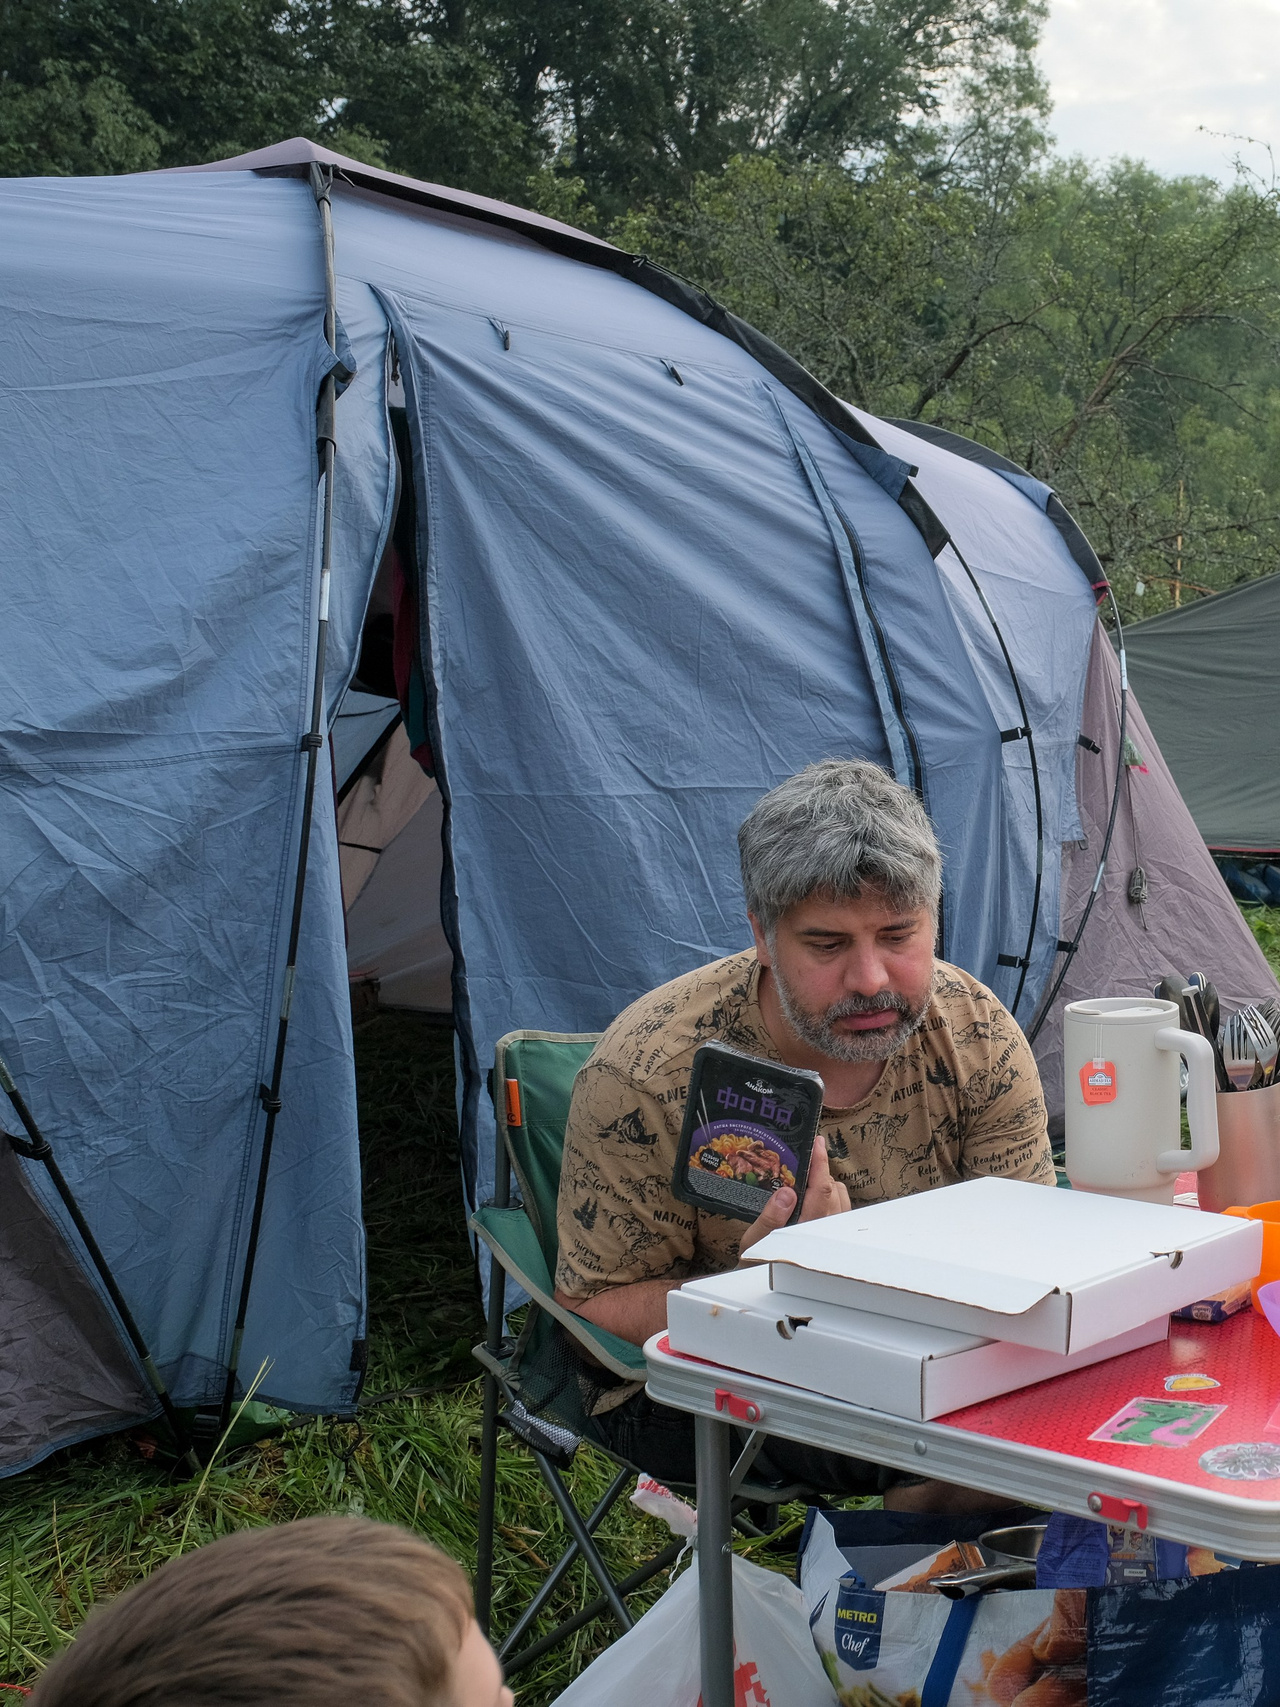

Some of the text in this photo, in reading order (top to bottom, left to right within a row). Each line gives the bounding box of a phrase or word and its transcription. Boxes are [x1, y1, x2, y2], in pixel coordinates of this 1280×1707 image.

[628, 1049, 645, 1078] natur
[644, 1048, 662, 1075] closer
[992, 1037, 1019, 1076] CAMPING
[973, 1152, 1001, 1168] Ready
[1006, 1147, 1015, 1156] to
[989, 1159, 1010, 1173] tent
[918, 1164, 938, 1178] Rela
[653, 1209, 698, 1231] NATURE
[573, 1238, 601, 1262] Chirping
[577, 1257, 605, 1274] crickets
[837, 1607, 878, 1624] METRO
[841, 1632, 870, 1657] Chef
